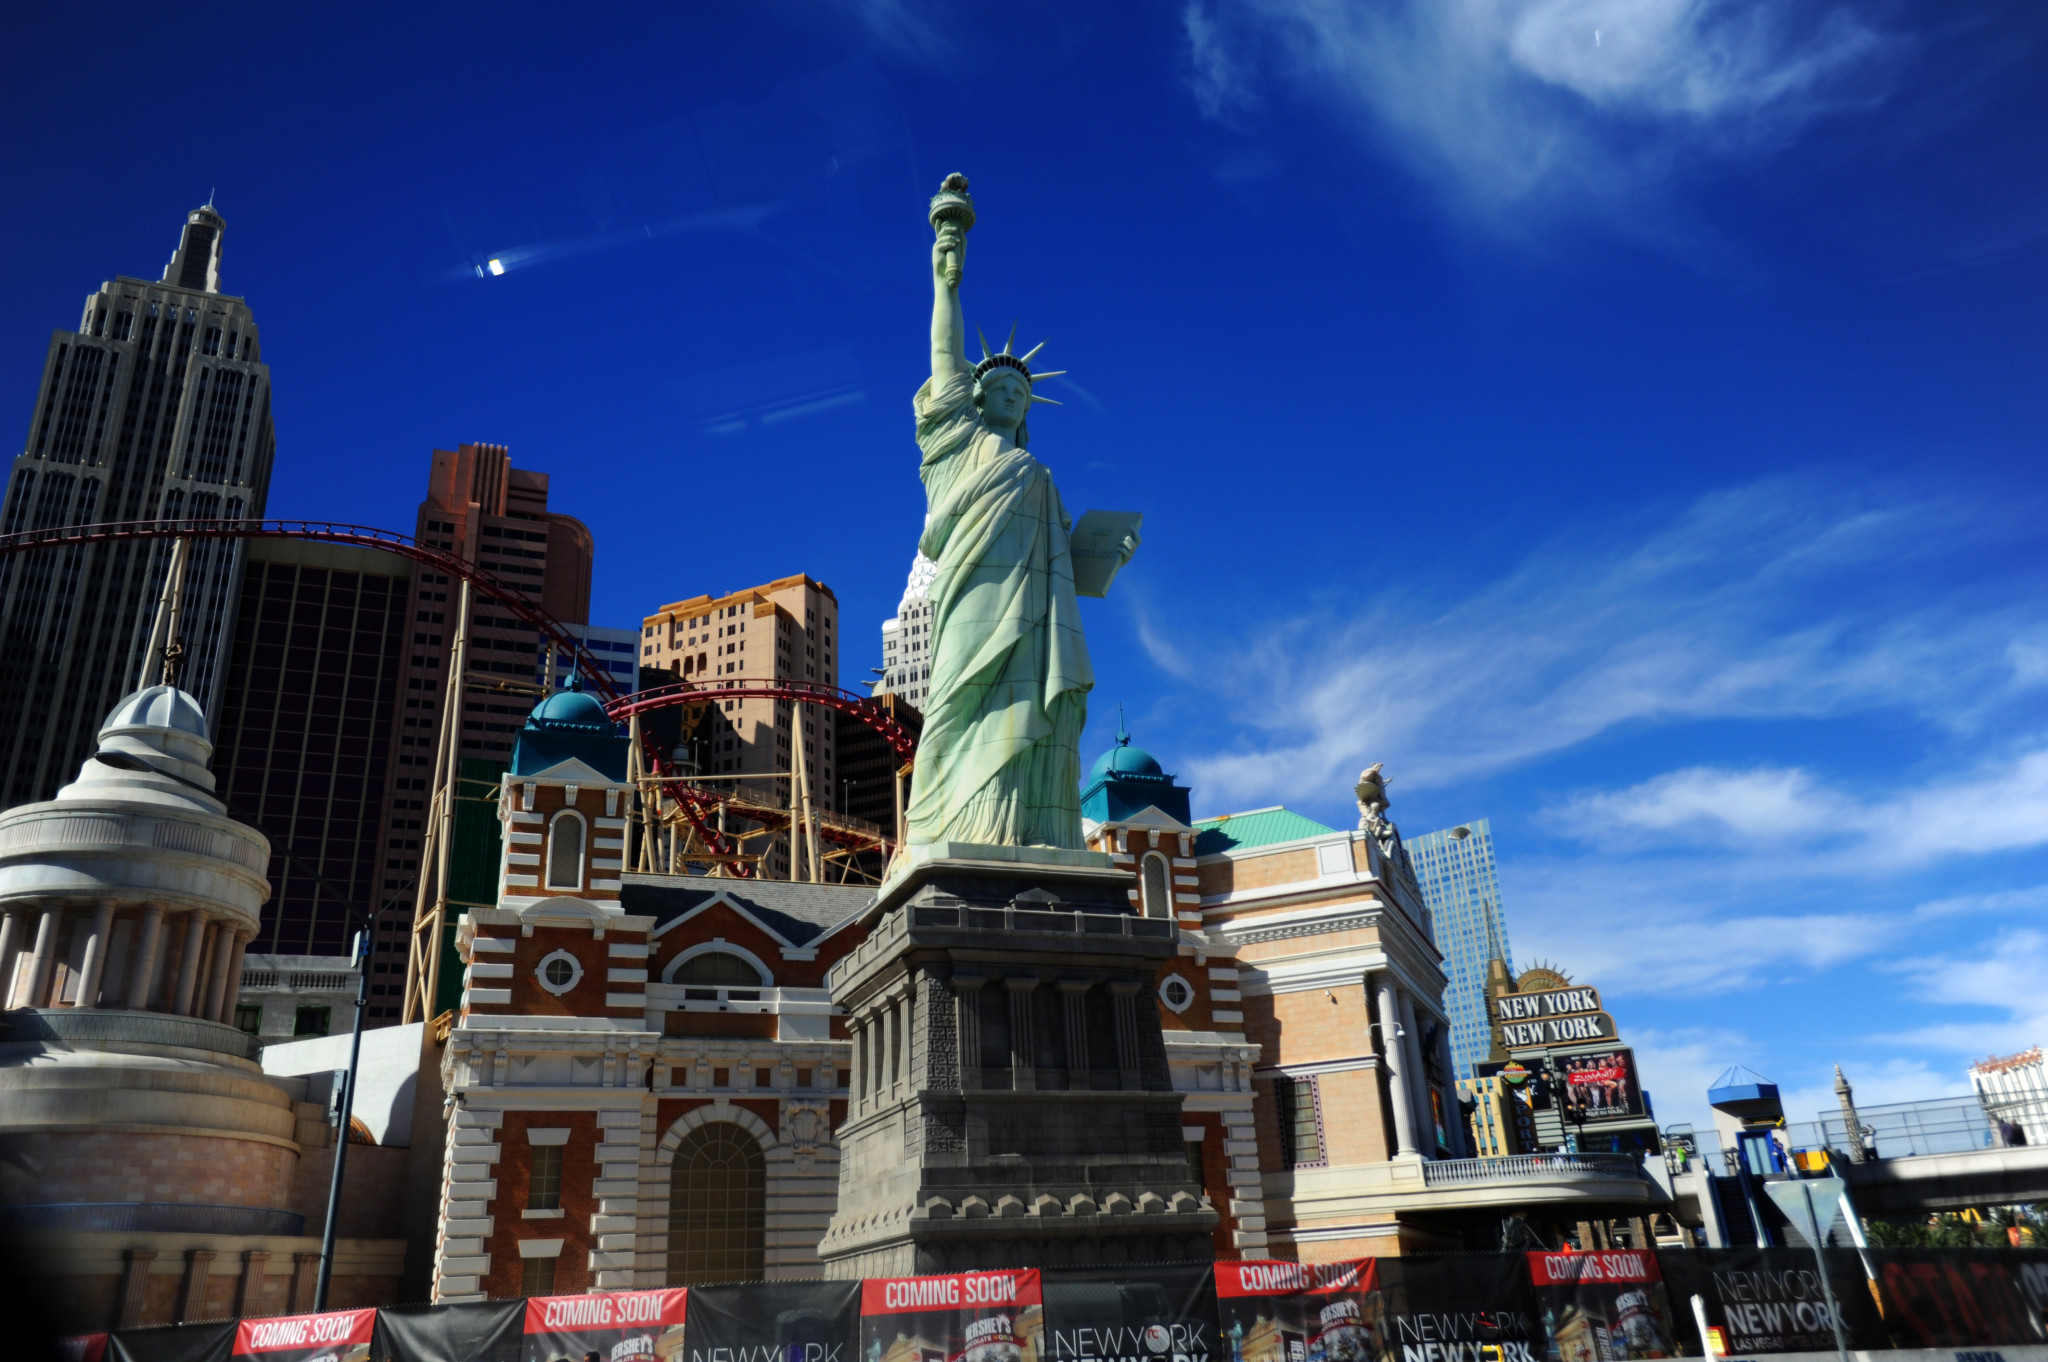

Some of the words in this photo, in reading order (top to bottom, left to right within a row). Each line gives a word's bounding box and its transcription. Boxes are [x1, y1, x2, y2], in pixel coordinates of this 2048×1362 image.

[1498, 996, 1540, 1019] NEW
[1543, 989, 1597, 1014] YORK
[1503, 1022, 1545, 1046] NEW
[1549, 1016, 1603, 1041] YORK
[1239, 1263, 1310, 1291] COMING
[1314, 1262, 1360, 1289] SOON
[1545, 1255, 1604, 1280] COMING
[1602, 1253, 1647, 1278] SOON
[885, 1278, 960, 1309] COMING
[965, 1275, 1017, 1303] SOON
[1713, 1270, 1771, 1302] NEW
[544, 1298, 613, 1327] COMING
[616, 1295, 664, 1322] SOON
[1397, 1312, 1458, 1342] NEW
[1460, 1311, 1529, 1339] YRK
[1723, 1302, 1784, 1335] NEW
[250, 1319, 310, 1349] COMING
[310, 1315, 356, 1343] SOON
[1055, 1326, 1124, 1358] NEW
[1402, 1341, 1464, 1362] NEW
[1466, 1340, 1539, 1362] YRK
